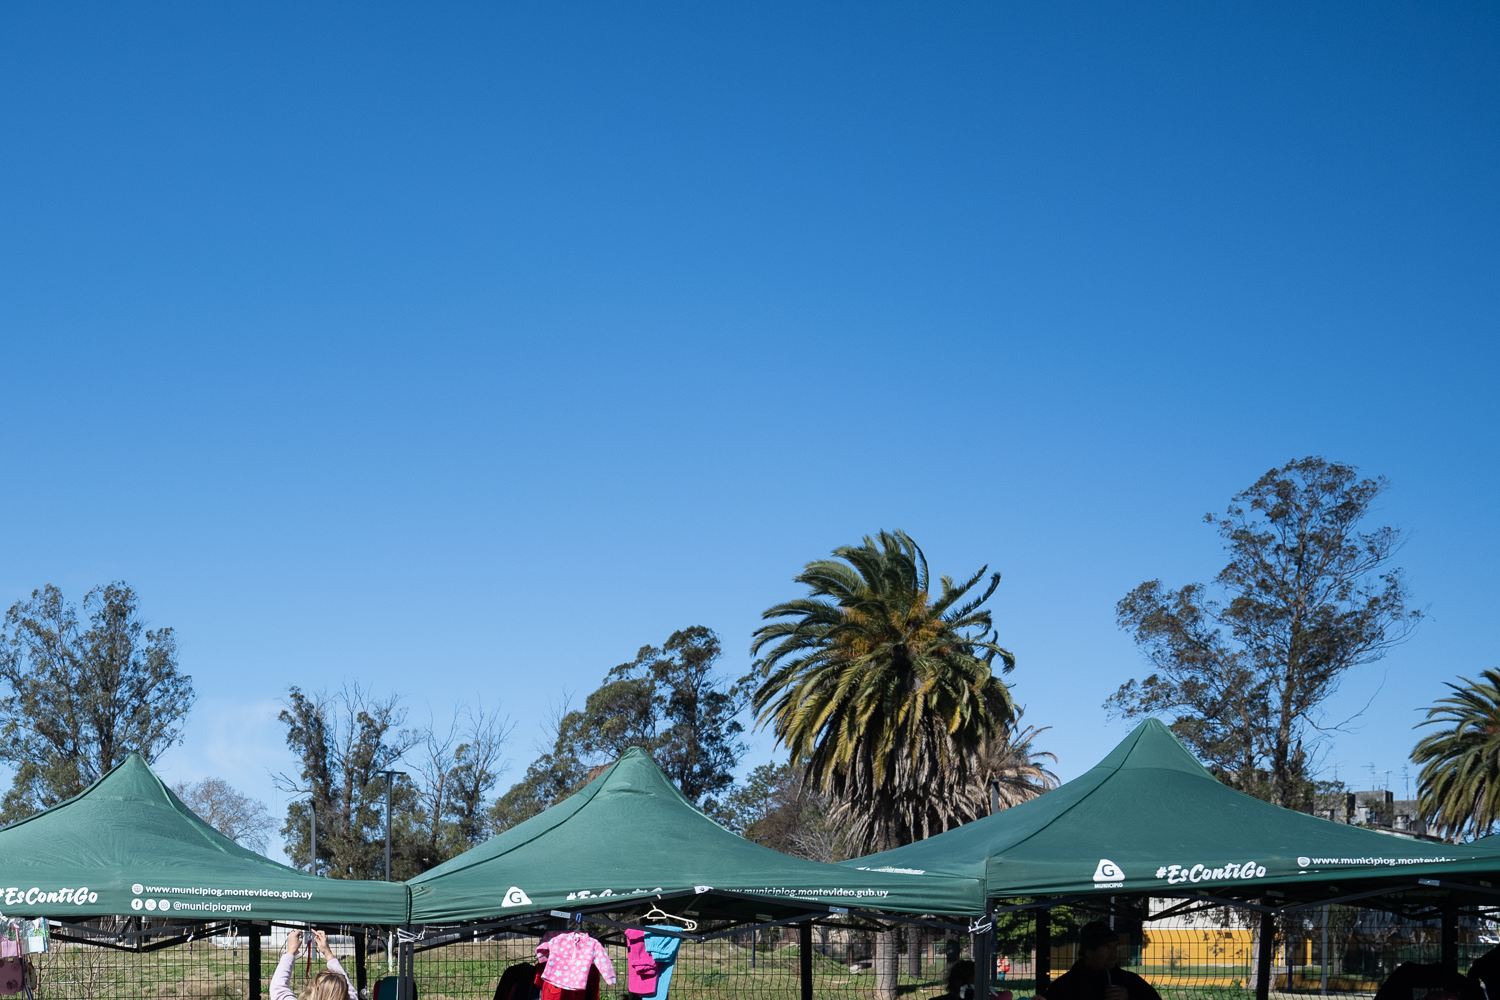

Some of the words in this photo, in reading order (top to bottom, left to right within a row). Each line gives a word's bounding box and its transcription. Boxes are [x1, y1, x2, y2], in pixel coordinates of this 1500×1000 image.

[1155, 861, 1267, 884] #EsContiGo
[145, 886, 313, 900] www.municipiog.montevideo.gub.uy
[173, 901, 252, 913] @municipiogmvd
